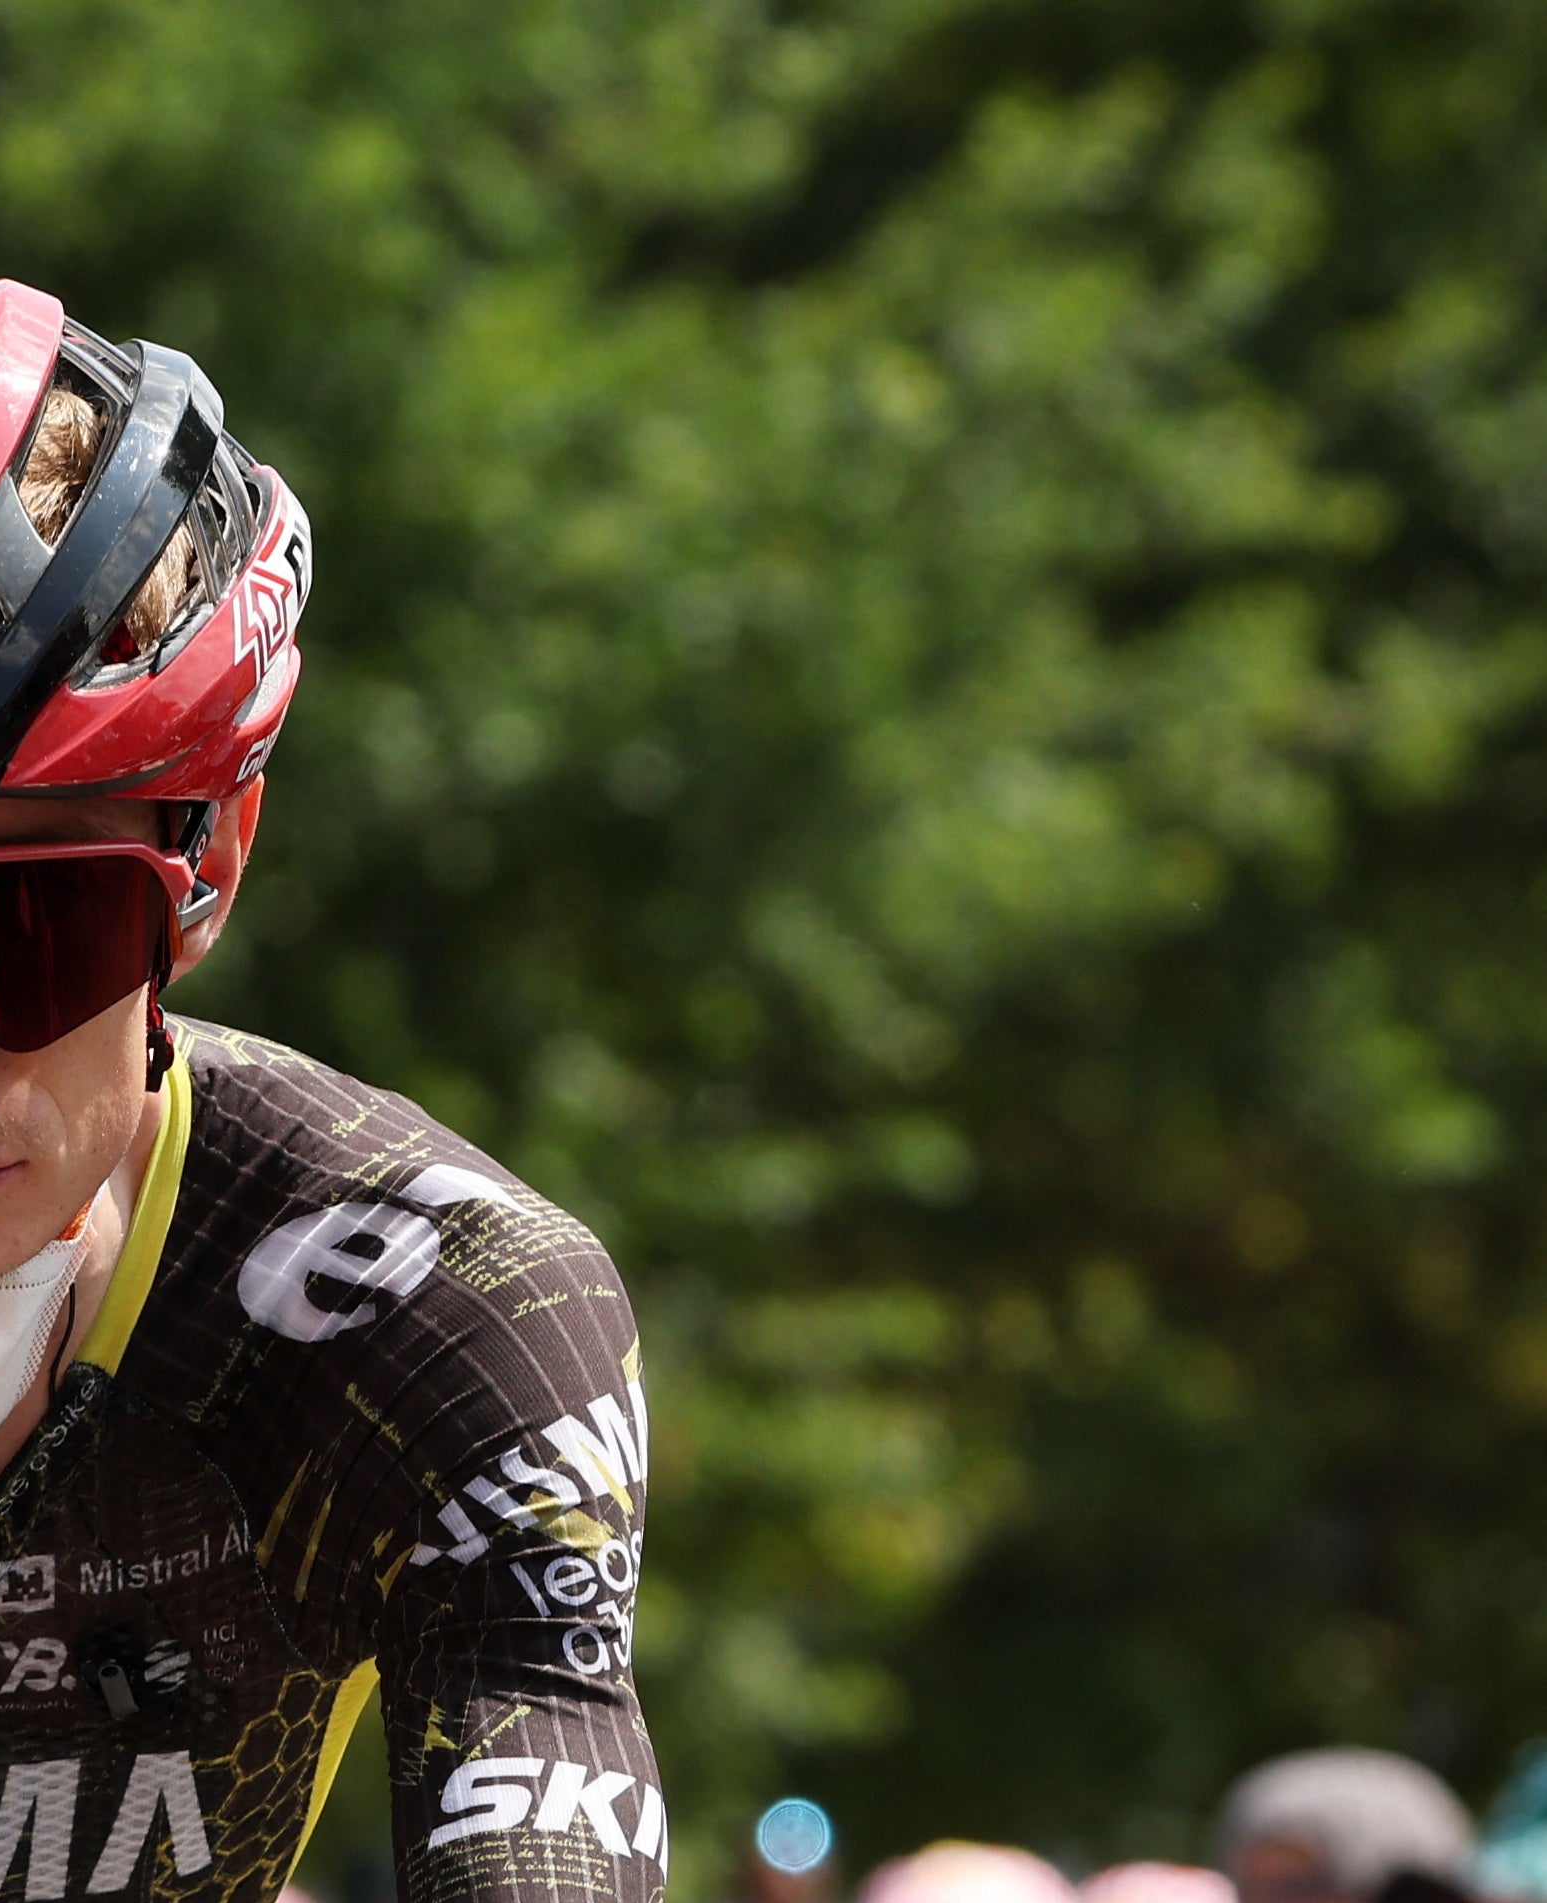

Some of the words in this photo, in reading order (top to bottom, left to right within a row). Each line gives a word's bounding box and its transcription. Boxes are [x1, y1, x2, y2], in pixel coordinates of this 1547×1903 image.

[79, 1535, 211, 1595] Mistral
[203, 1622, 238, 1644] UCI
[427, 1757, 668, 1884] SKI
